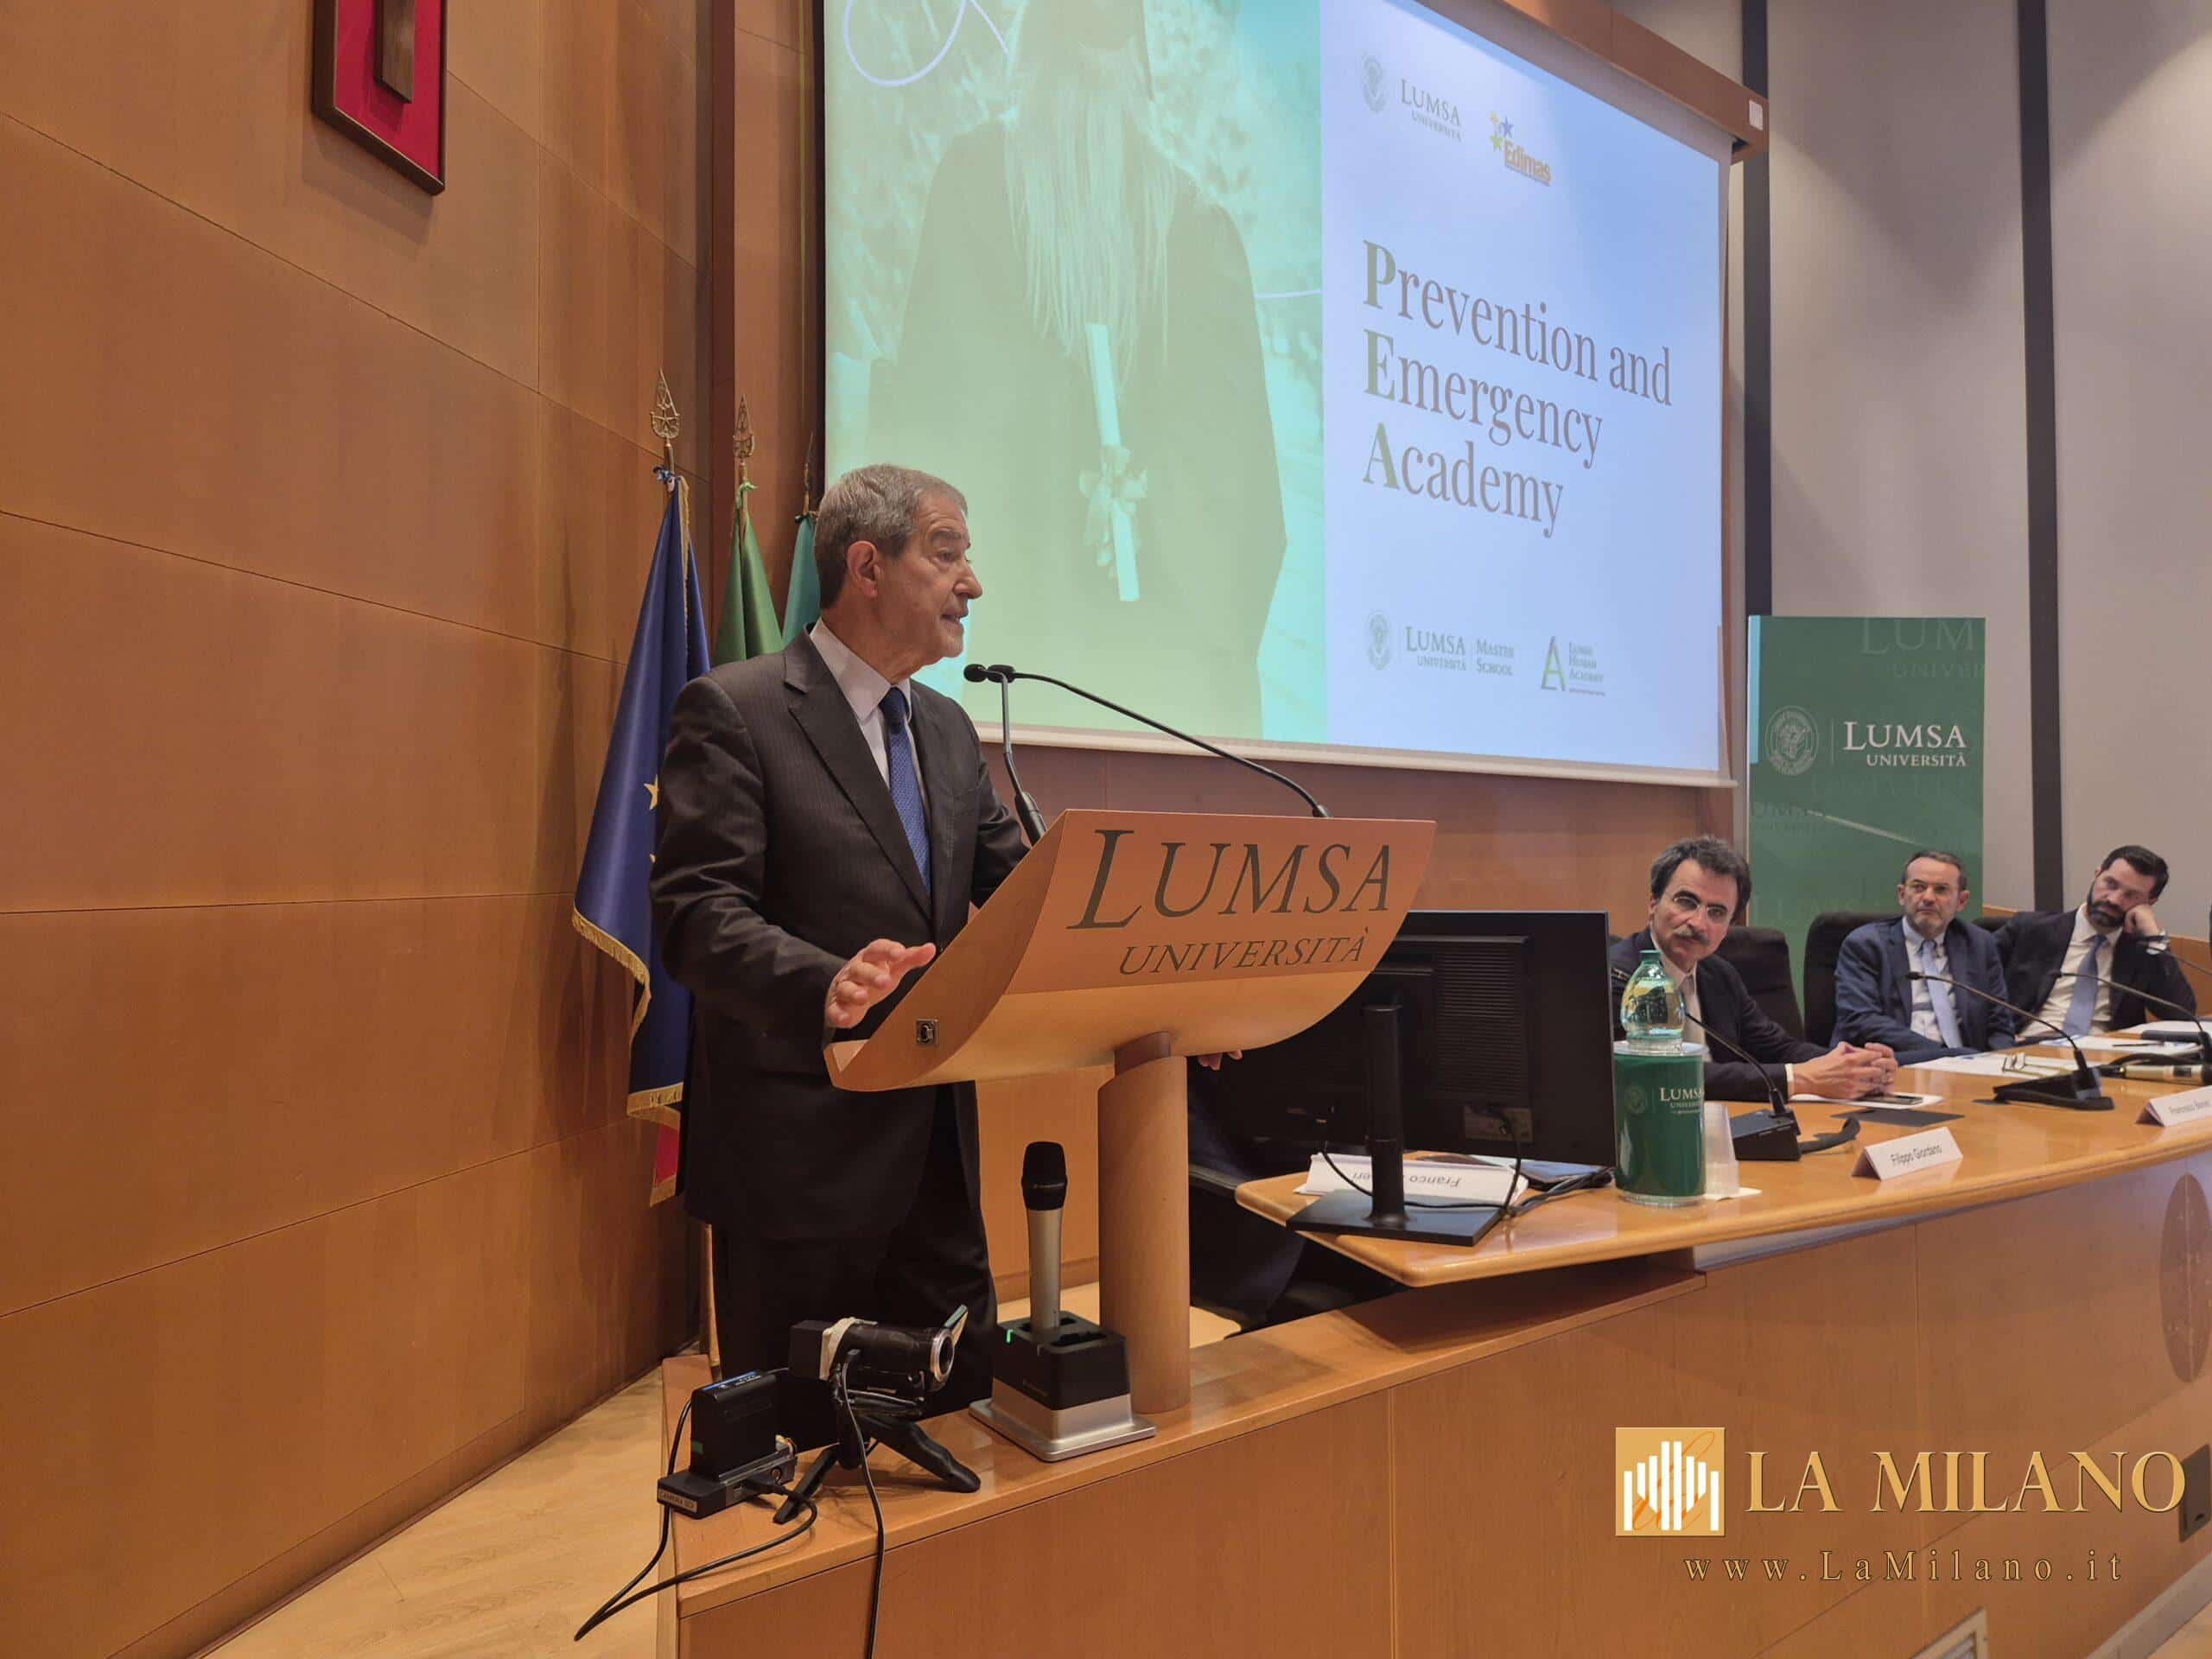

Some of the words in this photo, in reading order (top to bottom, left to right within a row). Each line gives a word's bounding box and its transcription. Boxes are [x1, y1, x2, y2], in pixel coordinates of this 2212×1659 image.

[1401, 78, 1461, 126] LUMSA
[1362, 239, 1599, 383] Prevention
[1608, 346, 1673, 406] and
[1363, 328, 1604, 470] Emergency
[1362, 422, 1564, 538] Academy
[1405, 626, 1466, 656] LUMSA
[1842, 721, 1967, 751] LUMSA
[1866, 752, 1967, 767] UNIVERSITÀ
[1065, 829, 1391, 931] LUMSA
[1118, 926, 1370, 976] UNIVERSITÀ
[1409, 1174, 1460, 1188] Franco
